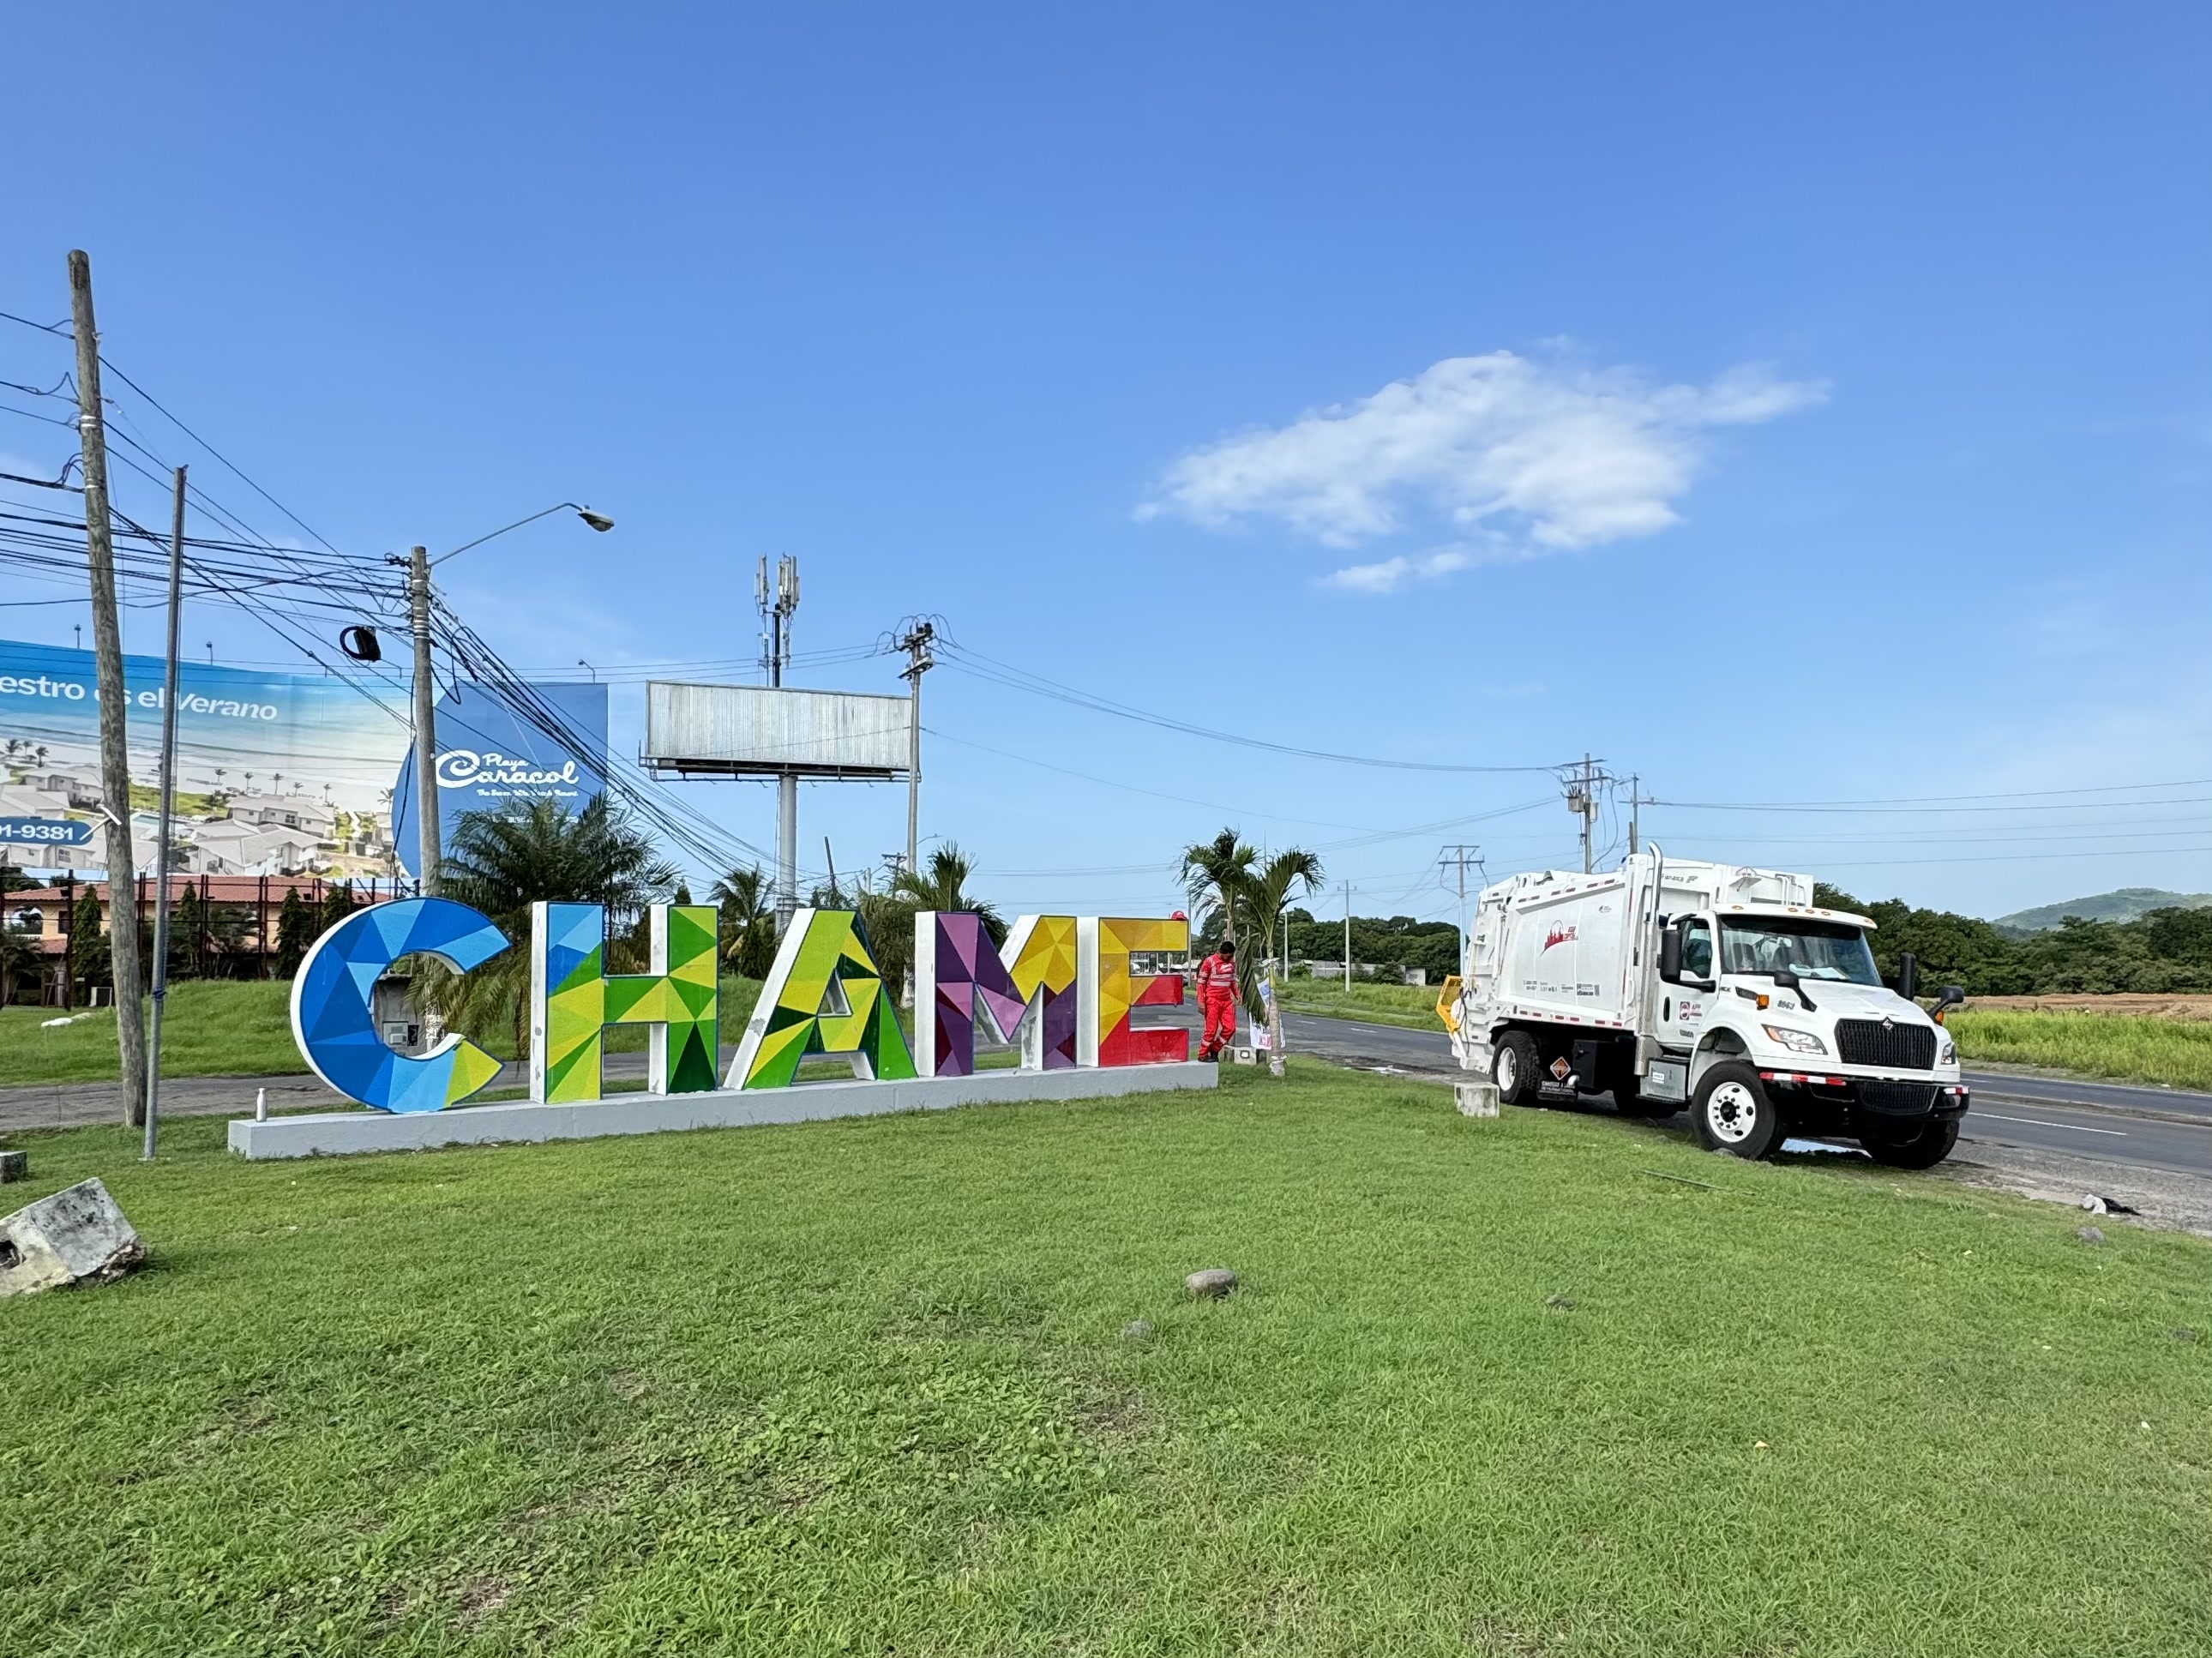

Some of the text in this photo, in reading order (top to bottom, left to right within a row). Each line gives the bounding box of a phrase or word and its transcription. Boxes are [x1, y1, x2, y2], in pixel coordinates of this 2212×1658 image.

[137, 688, 165, 708] el
[174, 692, 278, 721] Verano
[435, 750, 579, 788] Caracol
[482, 753, 530, 771] Playa
[0, 824, 74, 840] 1-9381
[291, 897, 1189, 1114] CHAME
